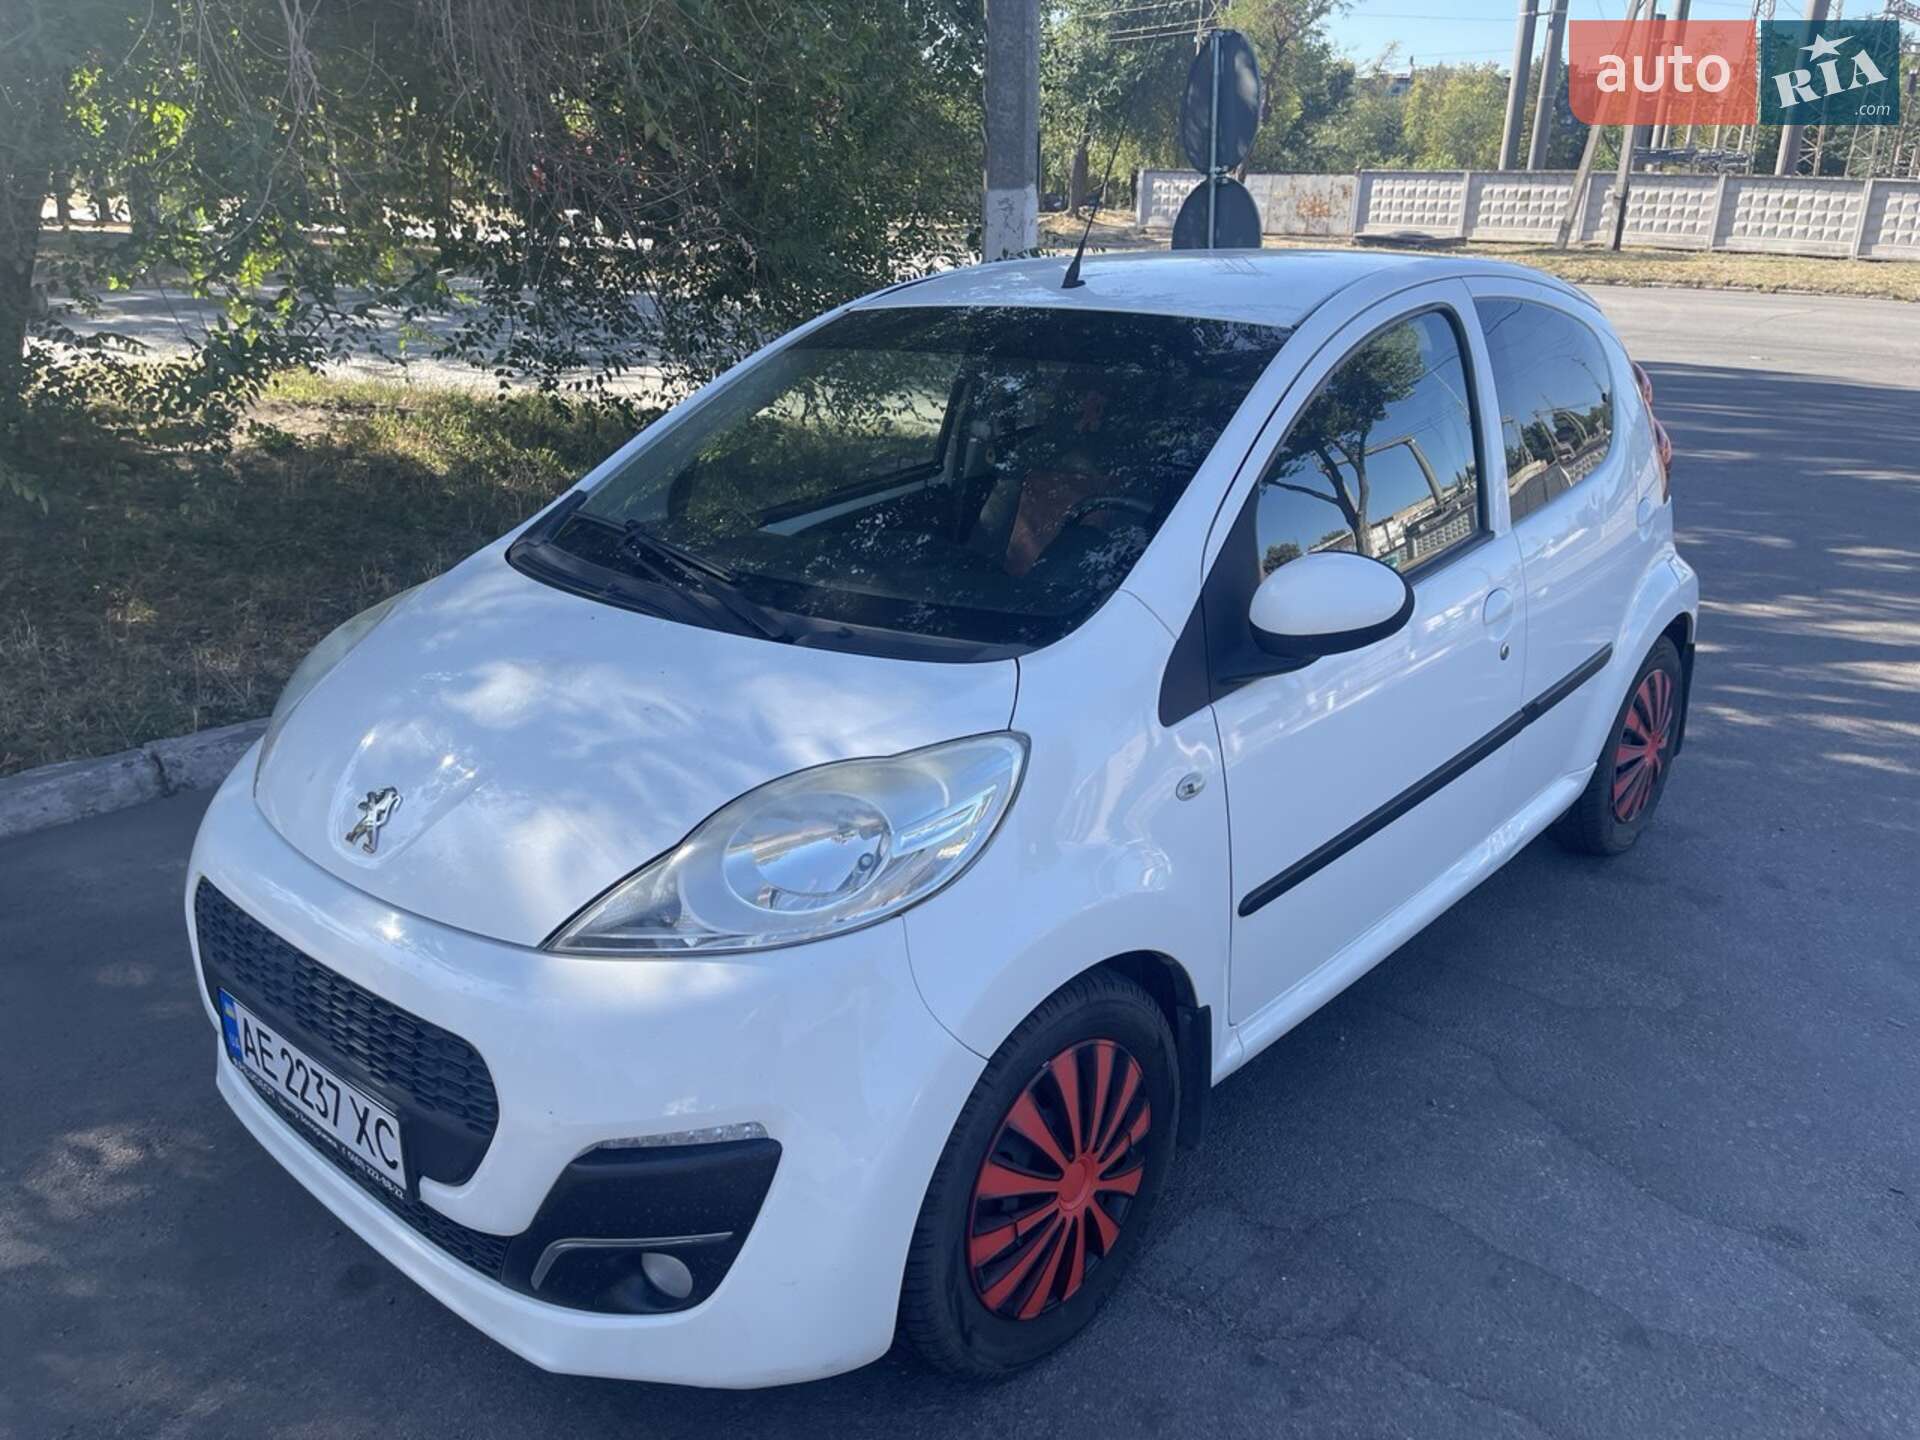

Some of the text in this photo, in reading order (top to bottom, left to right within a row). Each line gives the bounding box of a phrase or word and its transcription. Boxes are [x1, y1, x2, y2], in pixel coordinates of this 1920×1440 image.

[243, 1017, 279, 1082] AE
[280, 1047, 341, 1129] 2237
[349, 1095, 398, 1170] XC
